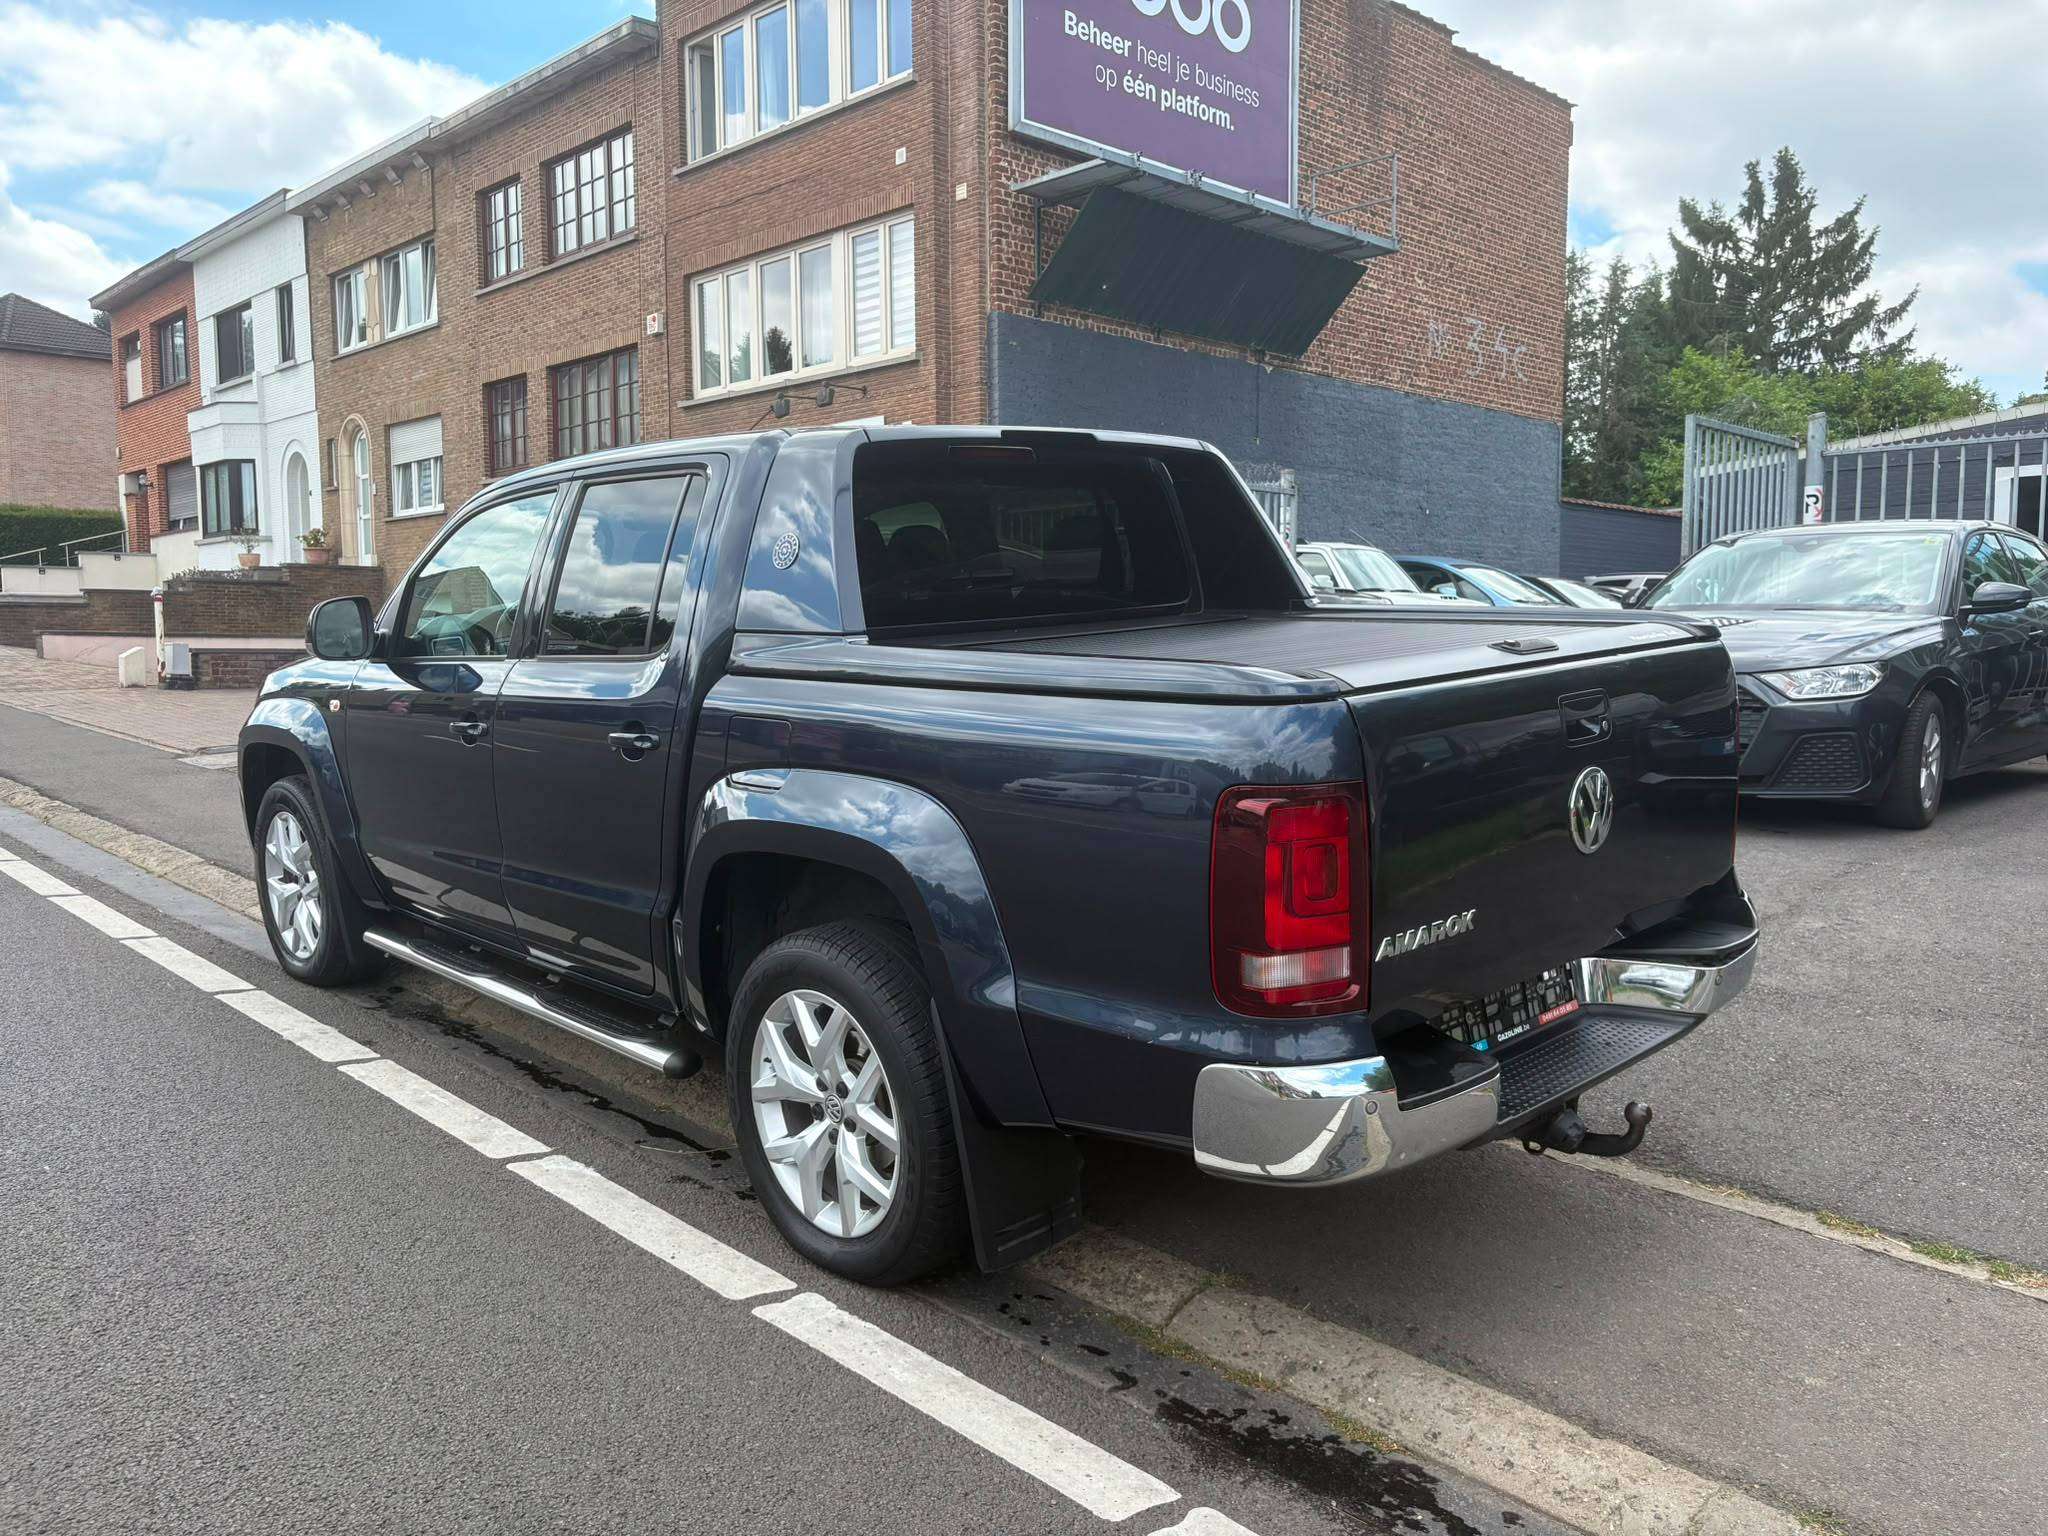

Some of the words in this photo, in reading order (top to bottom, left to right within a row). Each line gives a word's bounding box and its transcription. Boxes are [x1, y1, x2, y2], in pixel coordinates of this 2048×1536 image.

[1064, 9, 1132, 57] Beheer
[1137, 40, 1171, 74] heel
[1175, 55, 1190, 83] je
[1196, 63, 1260, 108] business
[1095, 64, 1117, 91] op
[1123, 70, 1156, 102] één
[1161, 87, 1235, 131] platform.
[1375, 909, 1476, 962] AMAROK
